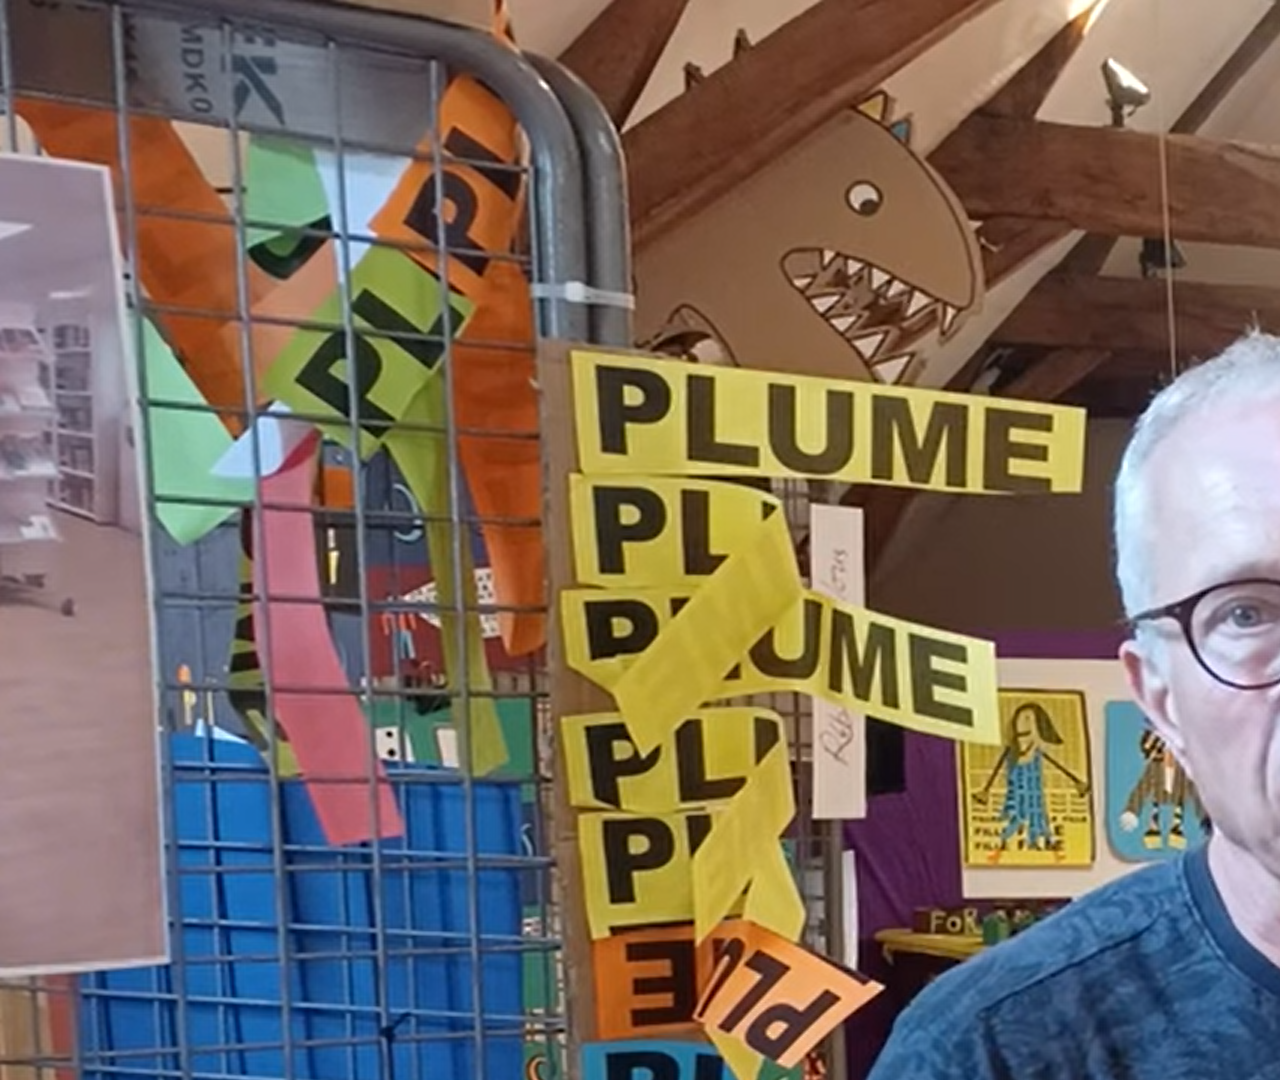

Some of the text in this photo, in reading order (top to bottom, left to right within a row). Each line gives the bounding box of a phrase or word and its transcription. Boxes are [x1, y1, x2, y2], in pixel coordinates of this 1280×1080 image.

[594, 363, 1054, 493] PLUME
[592, 485, 777, 576] PL
[583, 597, 975, 728] PUME
